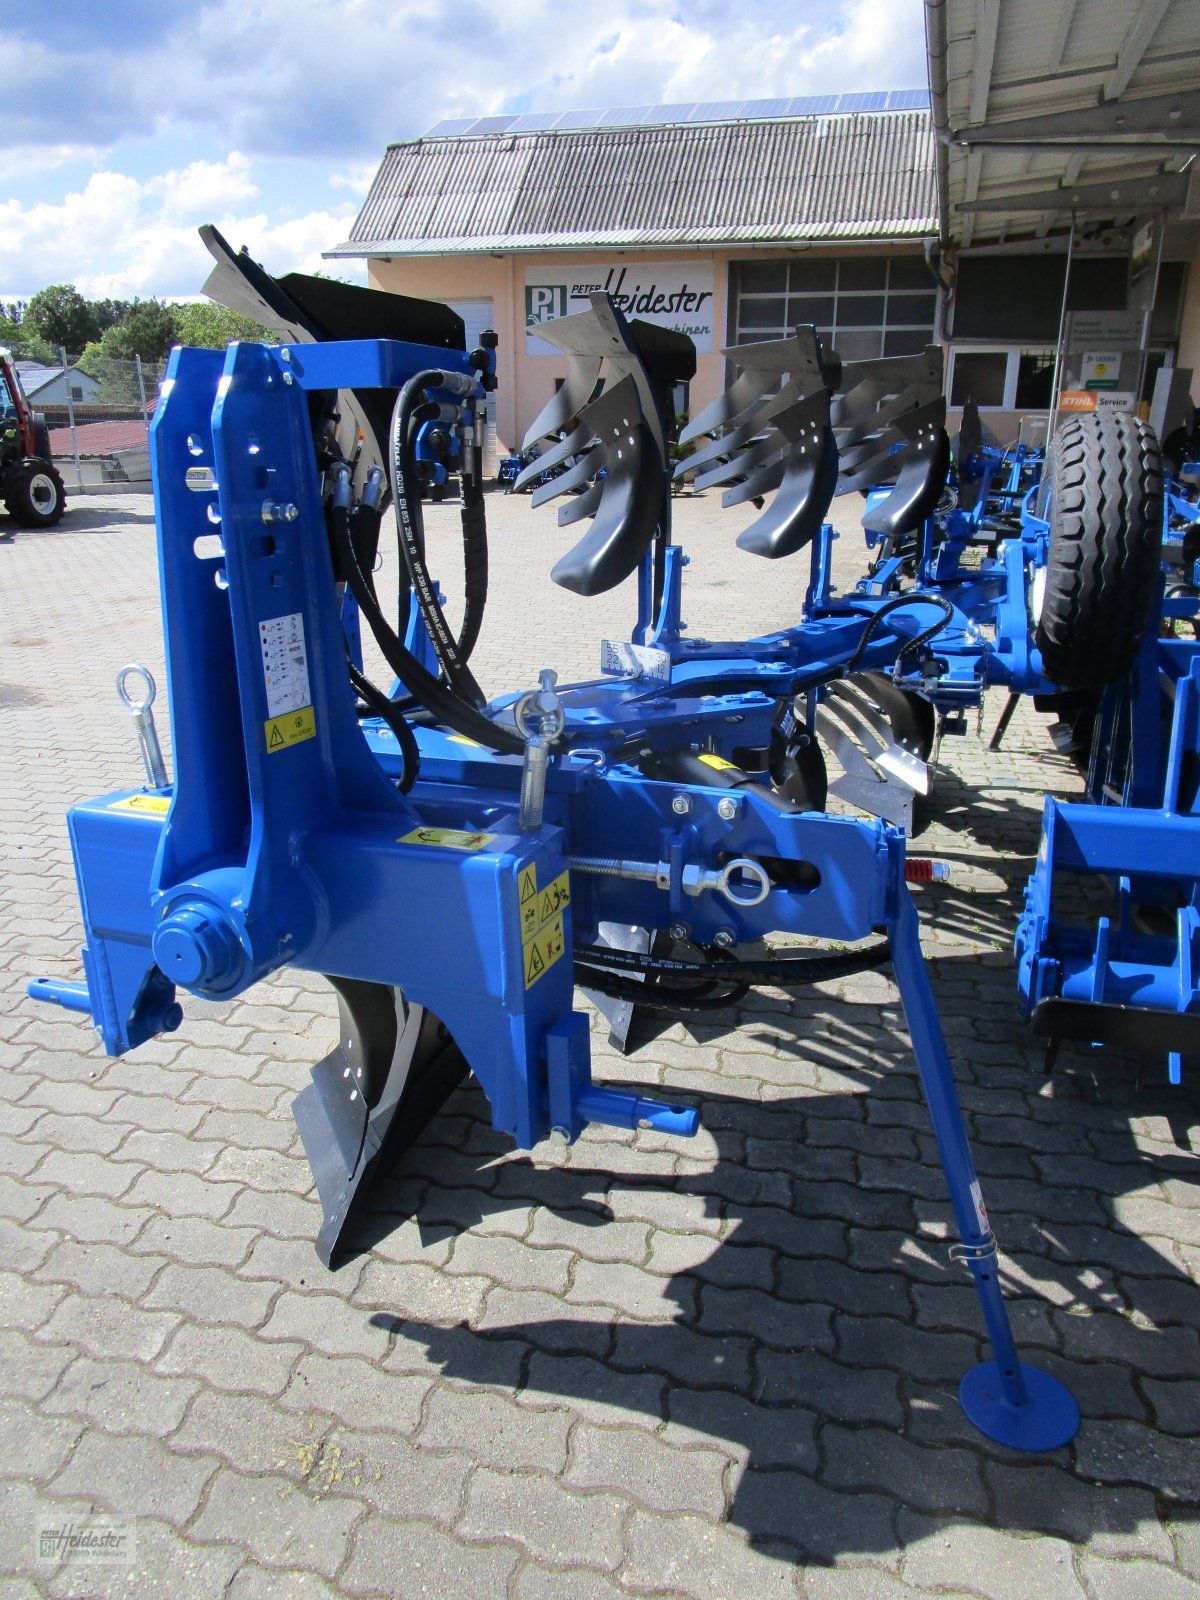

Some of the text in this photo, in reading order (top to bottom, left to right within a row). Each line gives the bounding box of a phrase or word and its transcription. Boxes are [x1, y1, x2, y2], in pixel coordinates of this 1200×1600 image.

[571, 284, 602, 294] PETER
[1061, 397, 1128, 406] STIHL Service
[400, 498, 408, 510] EN
[401, 510, 410, 524] 853
[422, 586, 432, 603] BAR
[606, 642, 619, 653] 55
[656, 652, 667, 664] 30
[606, 653, 619, 664] 22
[657, 663, 666, 675] 12
